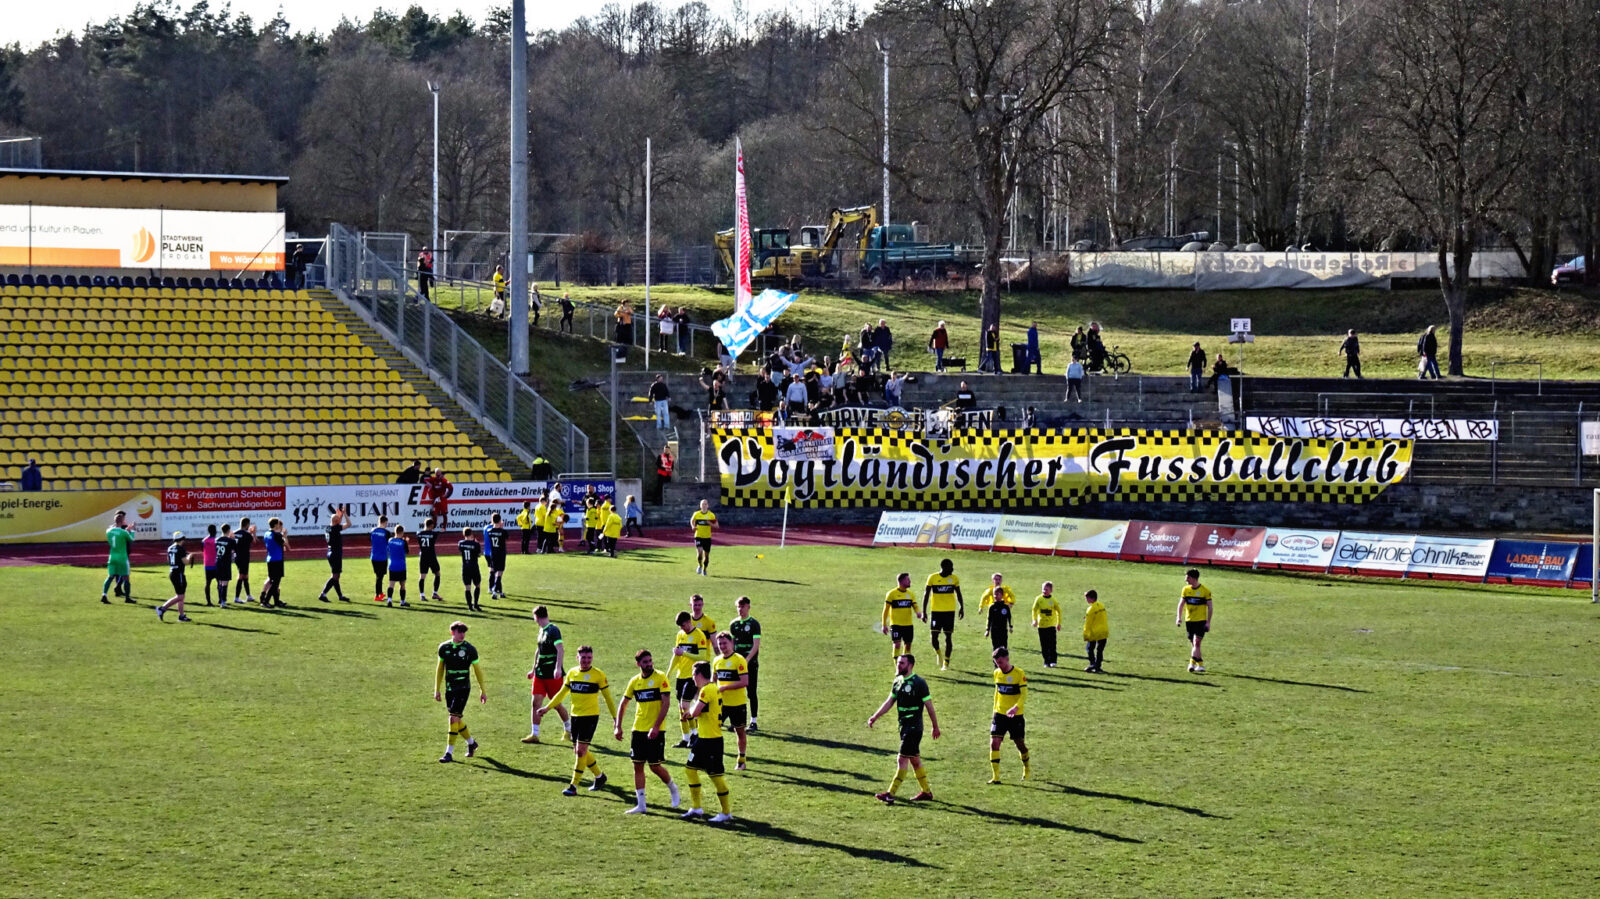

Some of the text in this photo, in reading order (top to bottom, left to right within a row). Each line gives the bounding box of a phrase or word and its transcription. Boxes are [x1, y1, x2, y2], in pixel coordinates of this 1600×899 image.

[40, 225, 61, 233] Kultur
[64, 225, 71, 233] in
[73, 225, 103, 235] Plauen.
[162, 243, 204, 252] PLAUEN
[220, 256, 233, 264] Wo
[235, 256, 263, 265] Wärme
[1259, 416, 1498, 440] KEIN TESTSPIEL GEGEN RB!
[720, 437, 1401, 501] Vogtländischer Fussballclub
[355, 489, 399, 497] RESTAURANT
[573, 483, 614, 494] Epsiln Shop
[165, 491, 179, 500] Kfz
[187, 490, 238, 500] Prüfzentrum
[240, 489, 282, 499] Scheibner
[0, 498, 64, 511] piel-Energie.
[197, 500, 282, 510] Sachverständigenbüro
[327, 501, 399, 518] SIRTAKI
[1015, 520, 1034, 528] Prozent
[878, 523, 920, 538] Sternquell
[951, 523, 997, 540] Sternquell
[111, 536, 117, 548] 1
[421, 537, 430, 548] 21
[491, 537, 500, 548] 12
[1149, 533, 1180, 543] Sparkasse
[1219, 537, 1251, 548] Sparkasse
[1145, 543, 1174, 553] Vogtland
[463, 549, 471, 561] 11
[1339, 542, 1461, 566] elektrotechnik
[1460, 551, 1486, 560] Plauen
[1458, 558, 1484, 567] GmbH
